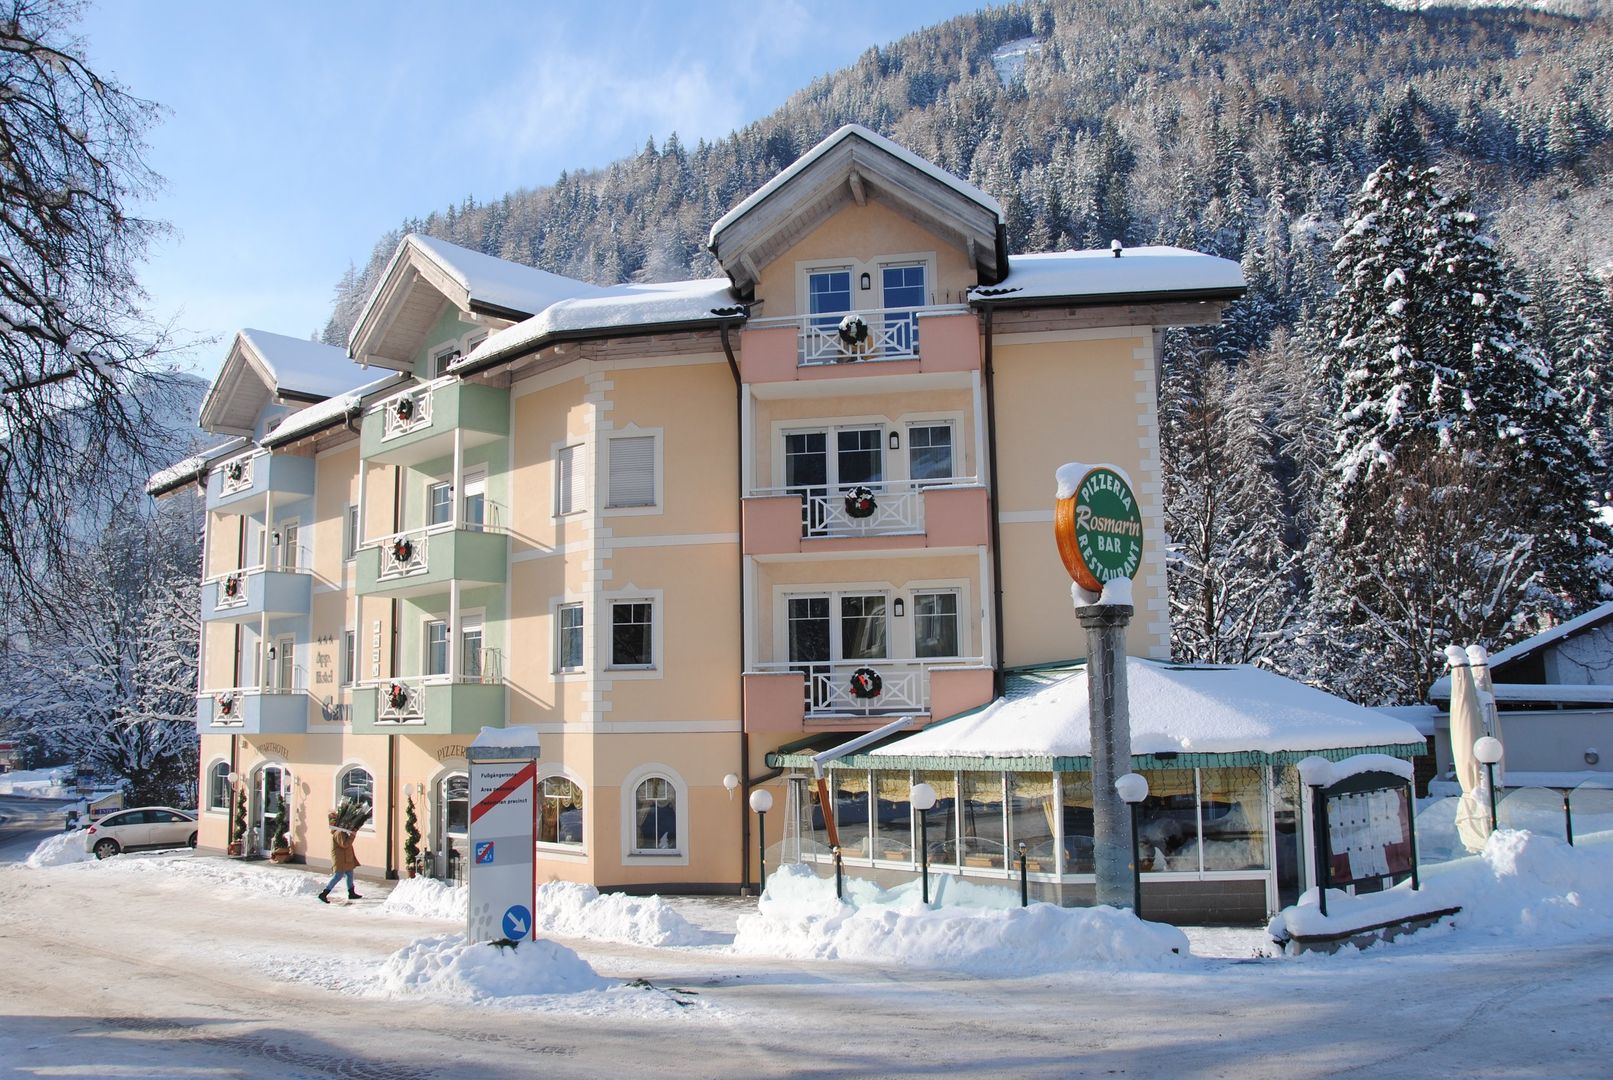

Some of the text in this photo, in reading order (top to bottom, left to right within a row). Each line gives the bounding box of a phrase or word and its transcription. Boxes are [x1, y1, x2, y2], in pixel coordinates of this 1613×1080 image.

[1081, 473, 1132, 512] PIZZERIA
[1076, 504, 1141, 537] Rosmarin
[1078, 533, 1140, 582] RESTAURANT
[1097, 535, 1122, 553] BAR
